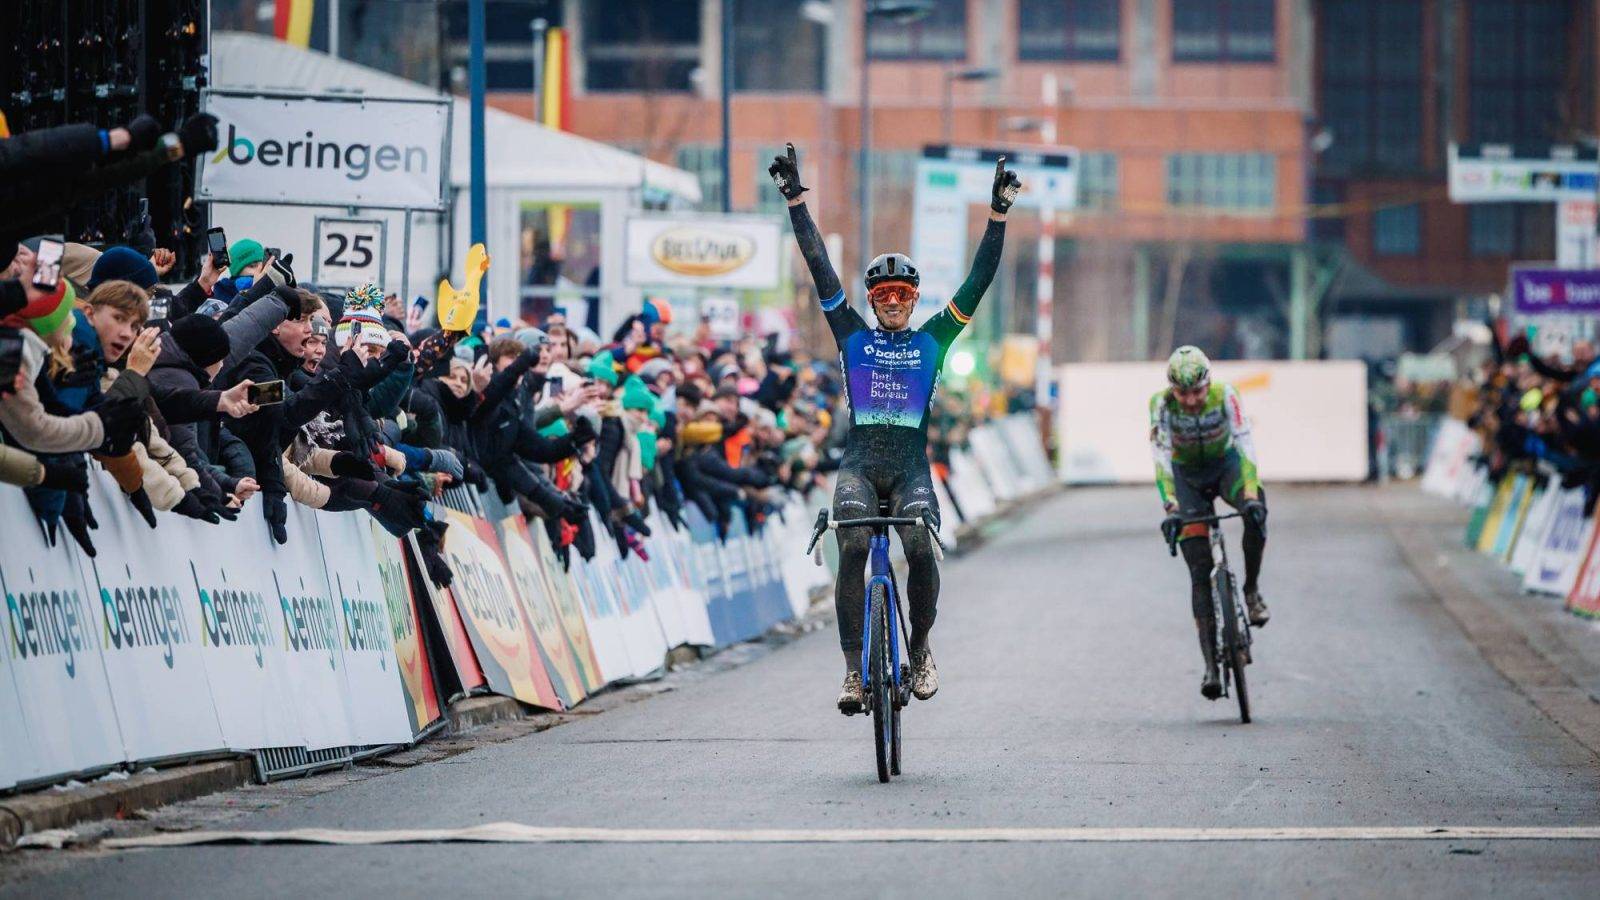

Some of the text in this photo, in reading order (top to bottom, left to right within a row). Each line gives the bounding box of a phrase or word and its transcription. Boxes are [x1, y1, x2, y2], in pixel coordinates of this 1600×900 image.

[226, 124, 428, 181] beringen
[324, 233, 373, 268] 25
[871, 390, 908, 399] bureau
[875, 348, 921, 359] baloise
[0, 562, 93, 679] beringen
[92, 557, 191, 669] beringen
[190, 559, 276, 669] beringen
[272, 568, 340, 671] beringen
[336, 571, 391, 671] beringen
